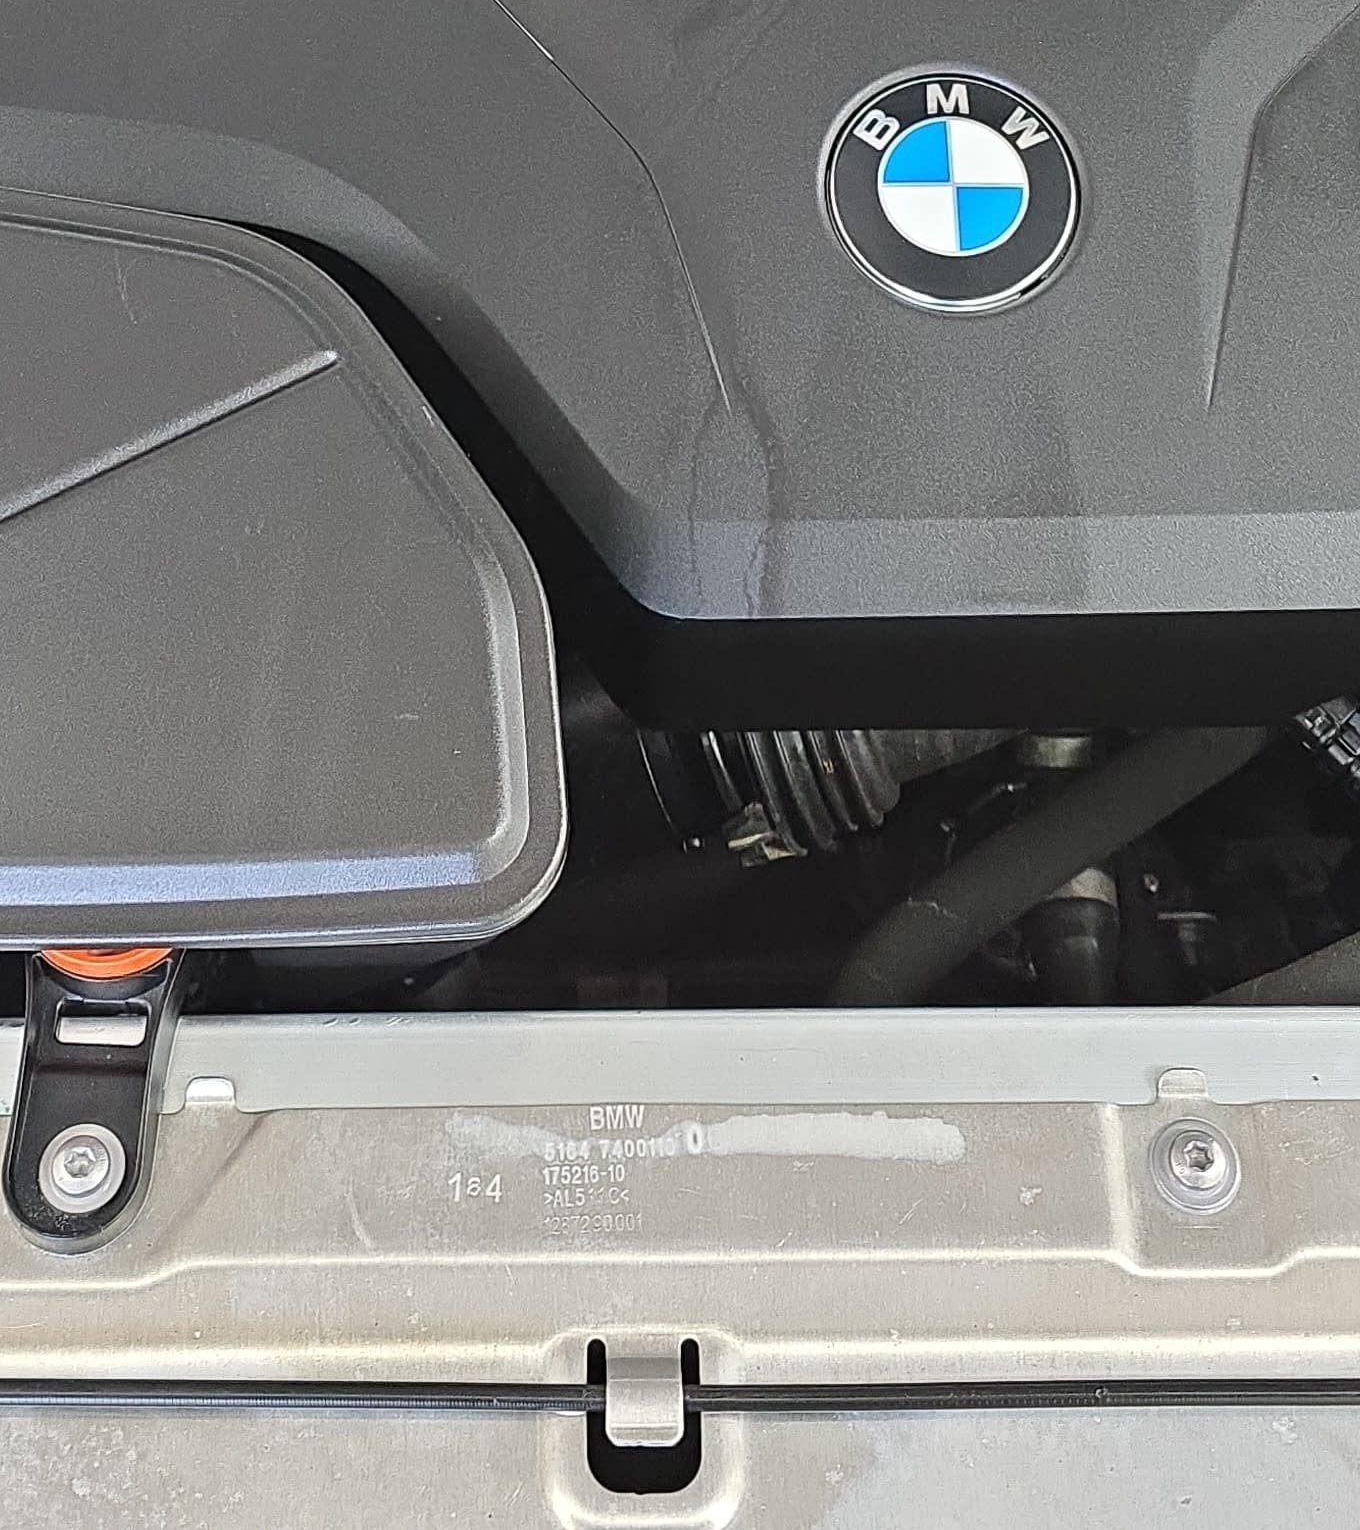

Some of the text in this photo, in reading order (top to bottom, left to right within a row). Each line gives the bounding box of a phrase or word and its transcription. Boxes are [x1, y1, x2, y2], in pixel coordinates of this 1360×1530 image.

[852, 83, 1050, 151] BMW
[590, 1105, 644, 1130] BMW
[542, 1164, 625, 1185] 175216-10
